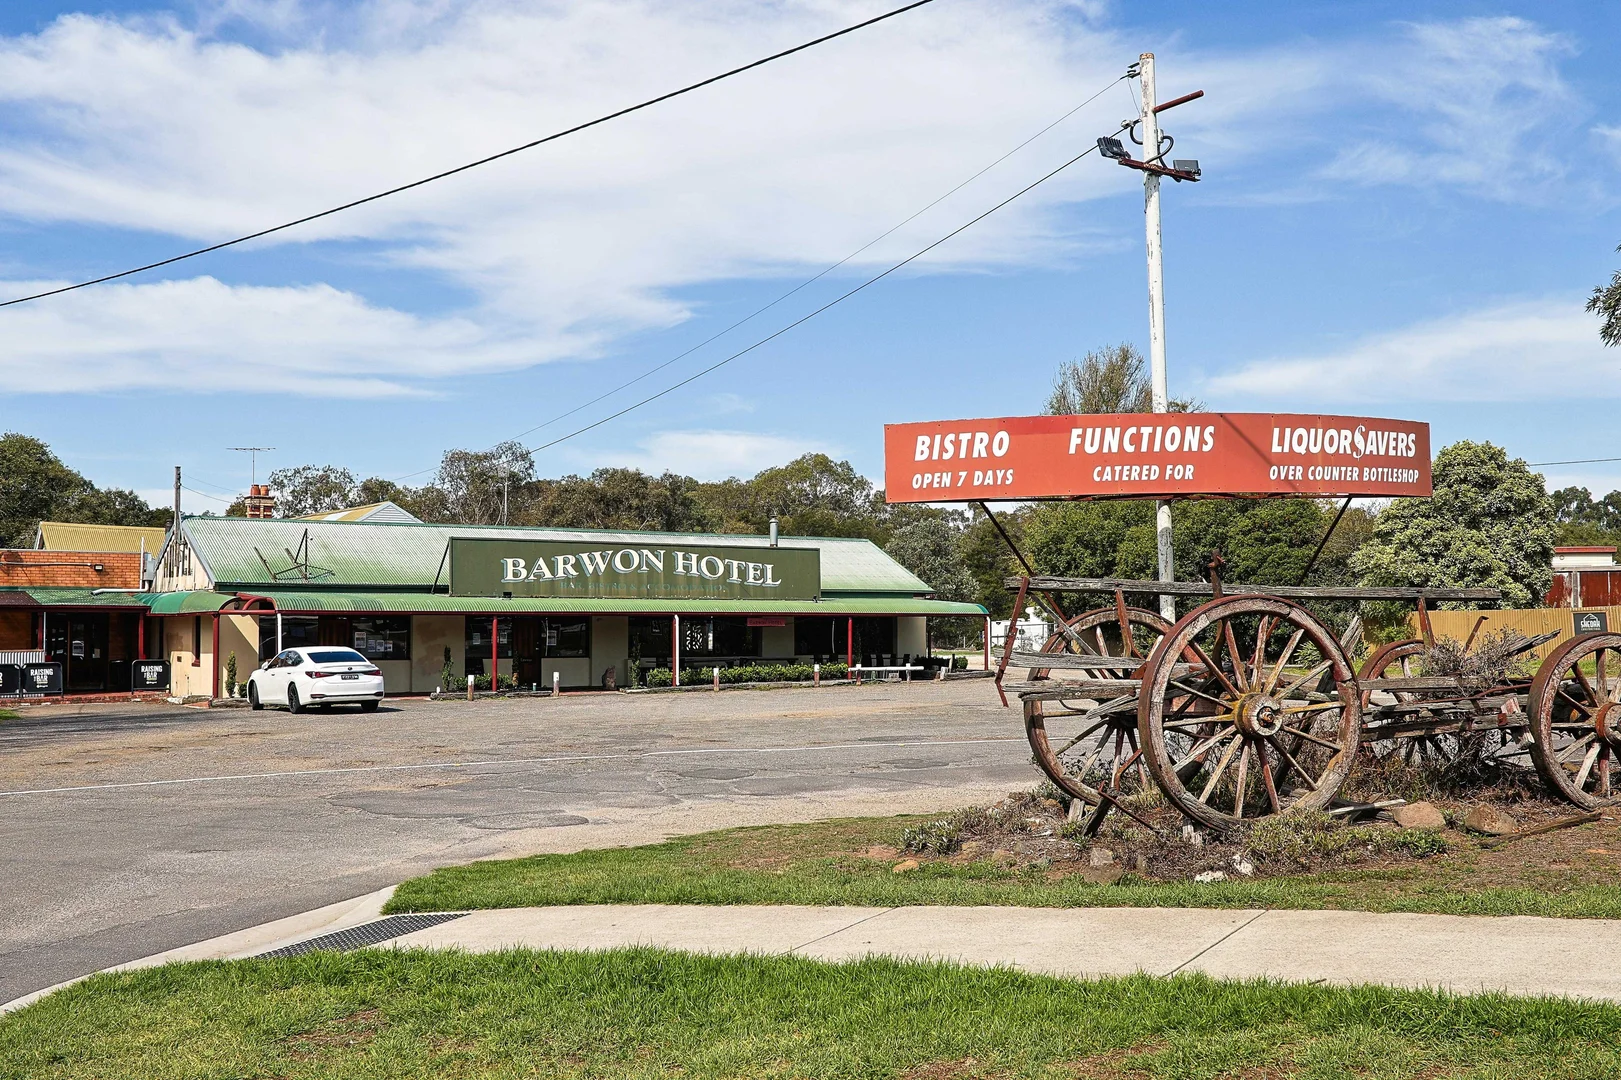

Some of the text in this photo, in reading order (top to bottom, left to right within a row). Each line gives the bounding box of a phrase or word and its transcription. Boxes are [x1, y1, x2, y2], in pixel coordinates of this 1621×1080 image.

[914, 430, 1010, 462] BISTRO
[1068, 425, 1215, 455] FUNCTIONS
[911, 468, 1014, 489] OPEN 7 DAYS
[1093, 464, 1195, 482] CATERED FOR
[1269, 465, 1420, 484] OVER COUNTER BOTTLESHOP
[500, 549, 782, 587] BARWON HOTEL
[30, 668, 54, 676] RAISING
[140, 665, 163, 673] RAISING
